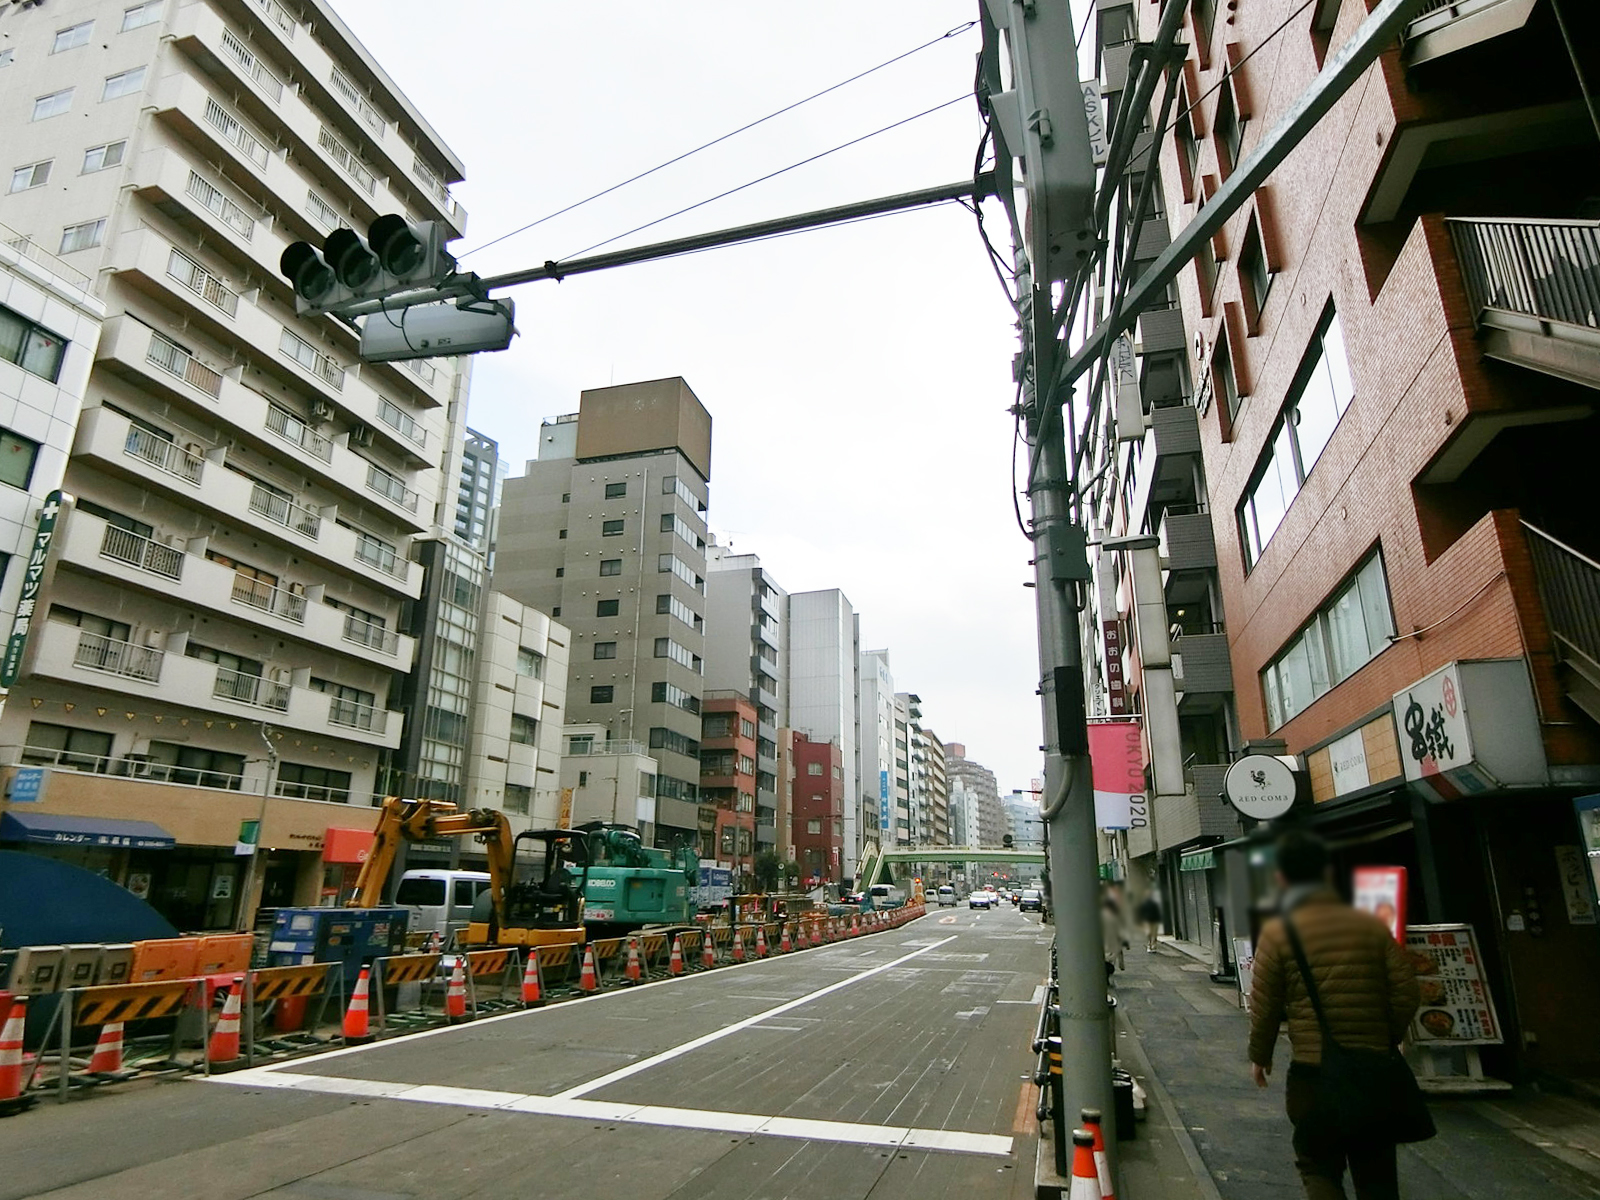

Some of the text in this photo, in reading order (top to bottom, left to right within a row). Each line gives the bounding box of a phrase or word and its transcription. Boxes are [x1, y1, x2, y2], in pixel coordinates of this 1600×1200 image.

[12, 532, 52, 636] マルマツ薬局
[1126, 724, 1147, 829] TOKYO 2020
[1238, 795, 1257, 803] RED
[54, 833, 91, 843] カレンダー
[587, 878, 616, 888] KOBELCO
